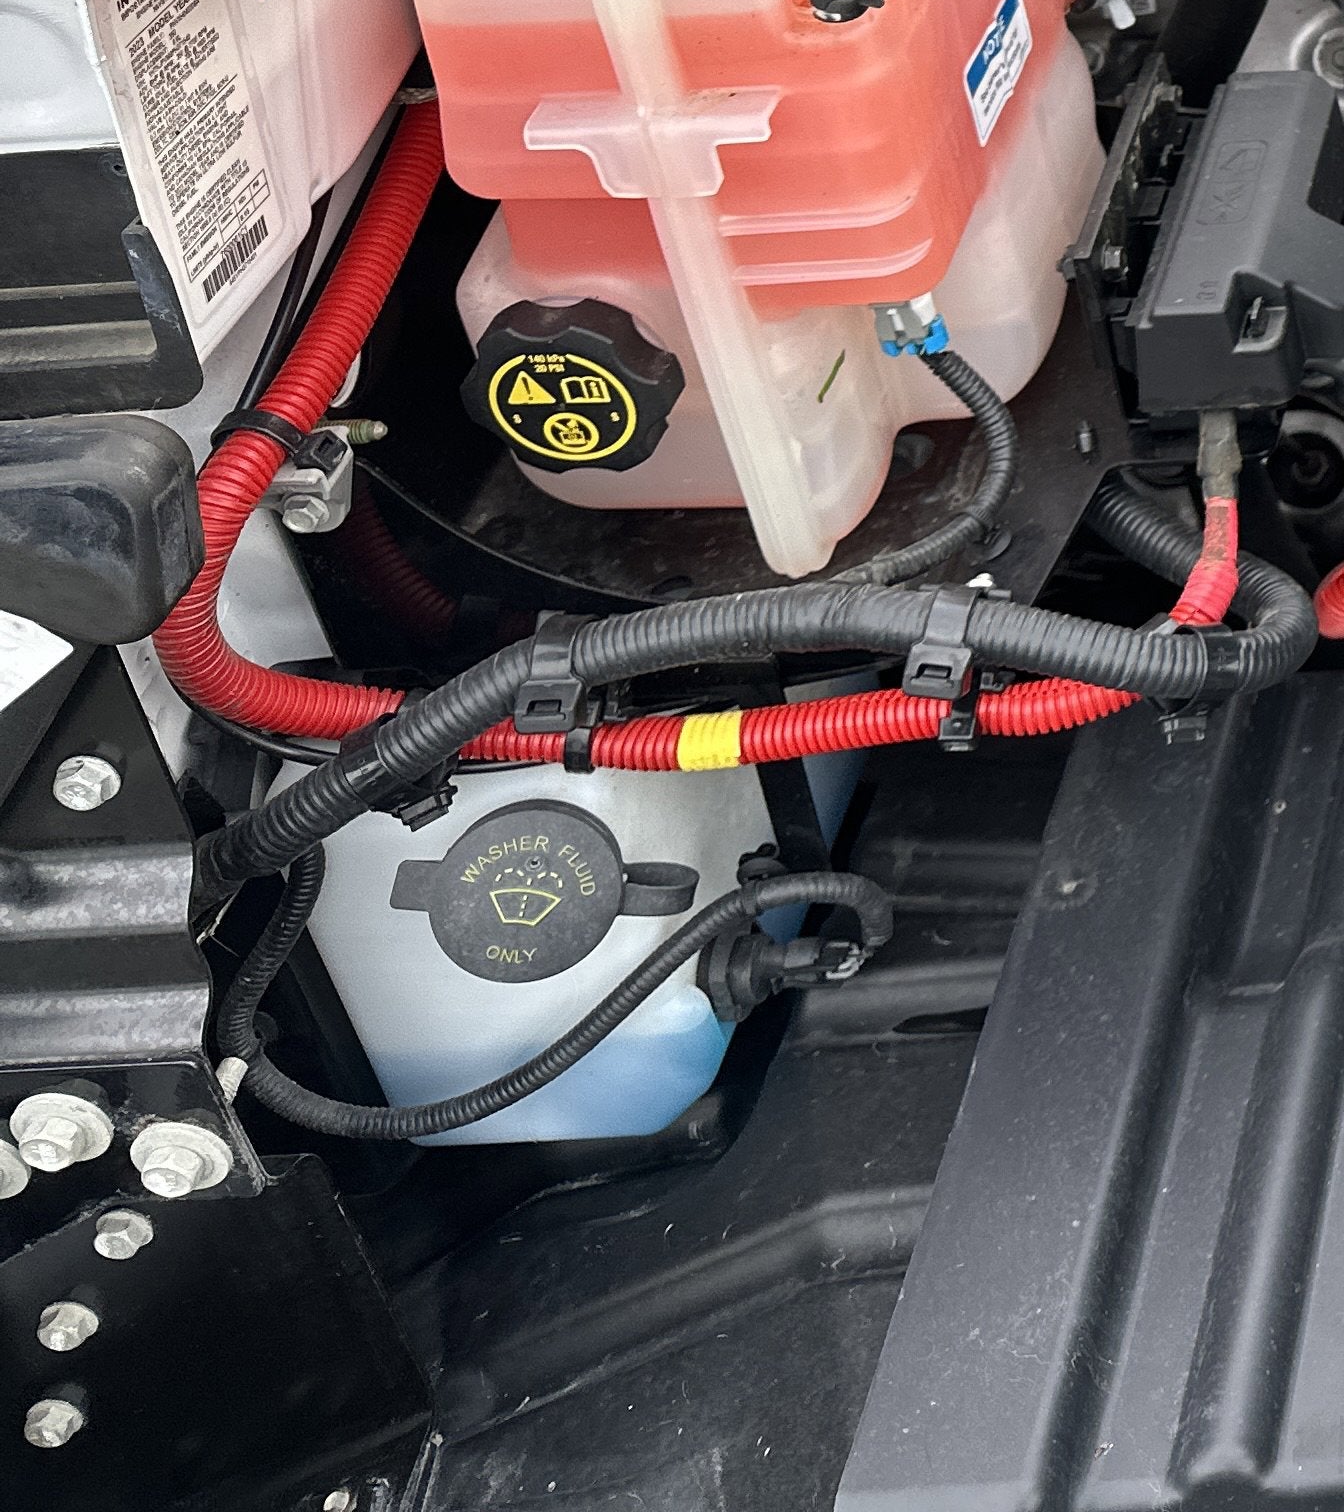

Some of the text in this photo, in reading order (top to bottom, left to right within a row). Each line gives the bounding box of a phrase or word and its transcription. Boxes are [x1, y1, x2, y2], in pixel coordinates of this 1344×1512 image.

[460, 835, 597, 898] WASHER FLUID
[485, 944, 538, 965] ONLY
